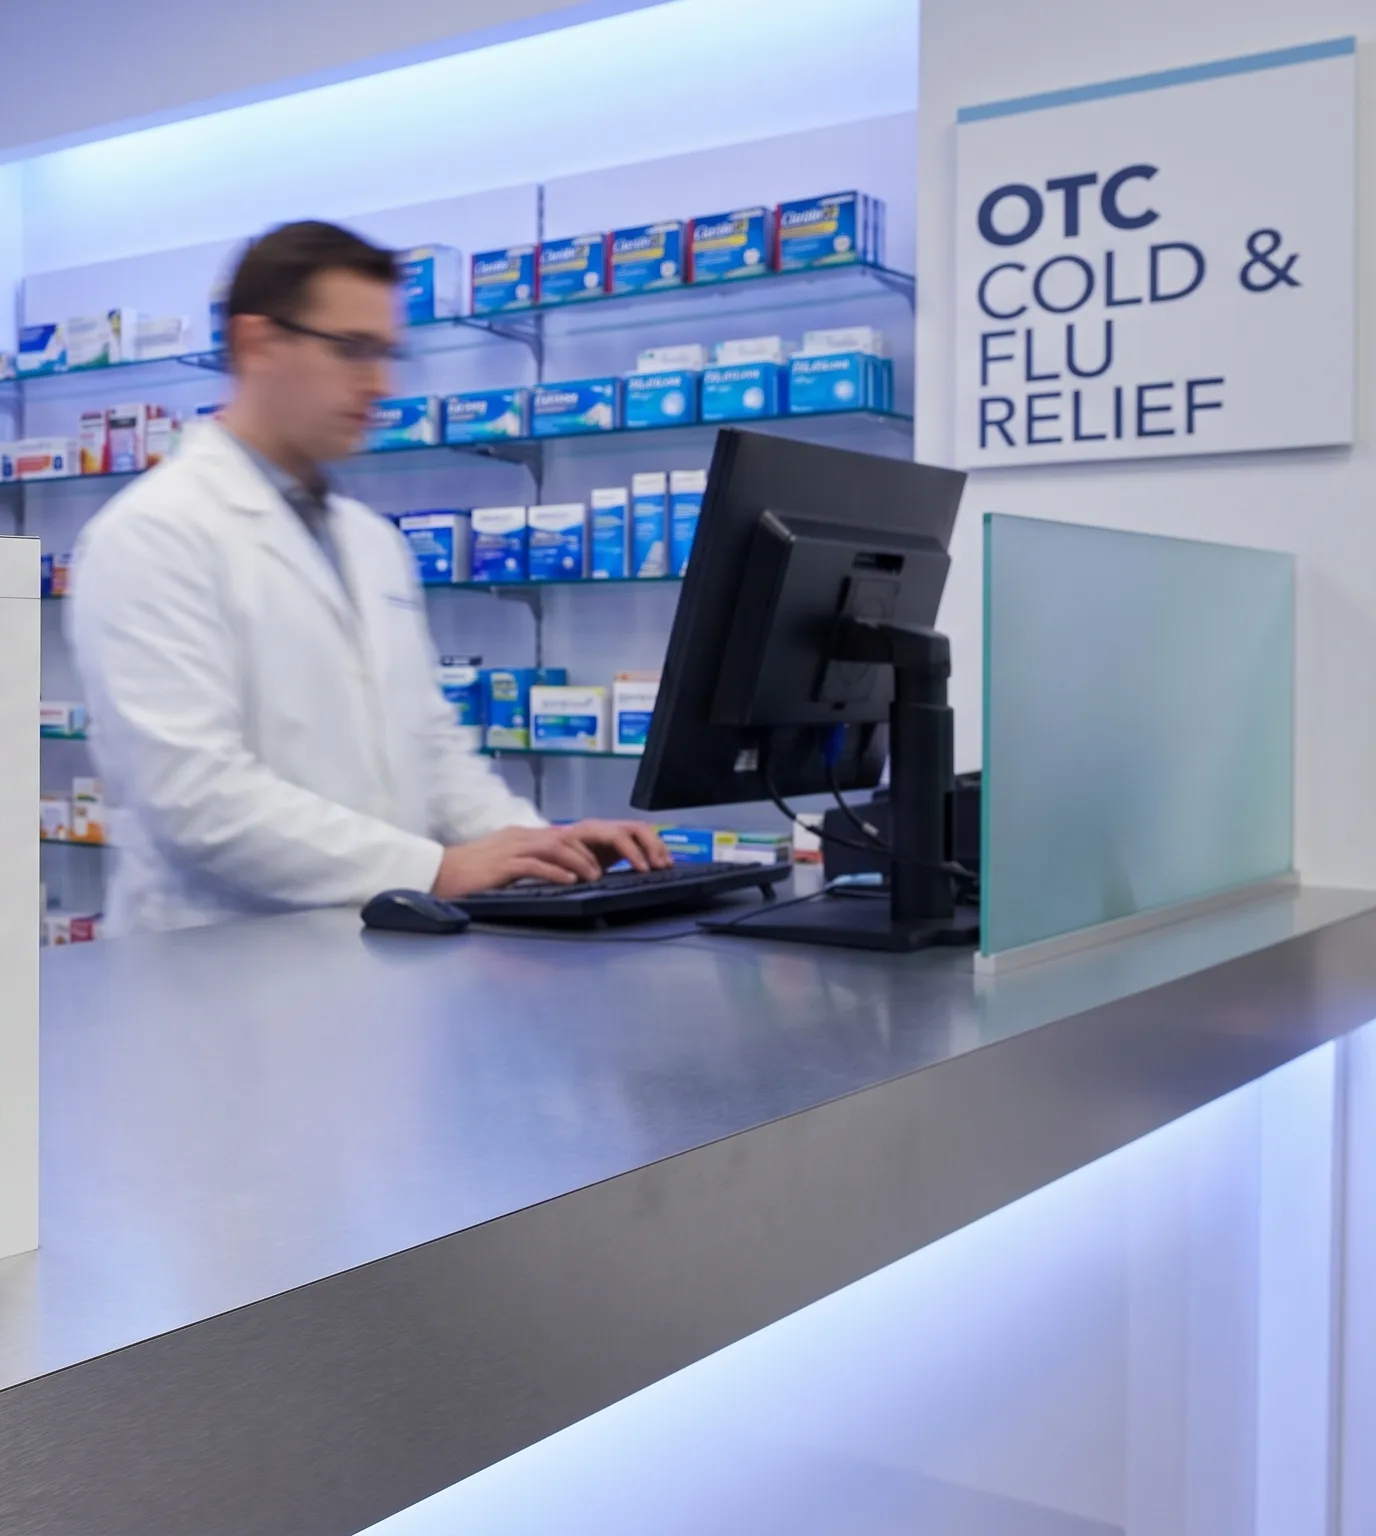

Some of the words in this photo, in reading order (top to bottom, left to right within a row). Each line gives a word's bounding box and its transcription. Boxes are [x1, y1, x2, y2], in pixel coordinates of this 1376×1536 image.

[977, 163, 1161, 248] OTC
[977, 241, 1207, 321] COLD
[1237, 227, 1304, 293] &
[980, 318, 1115, 387] FLU
[978, 376, 1226, 449] RELIEF
